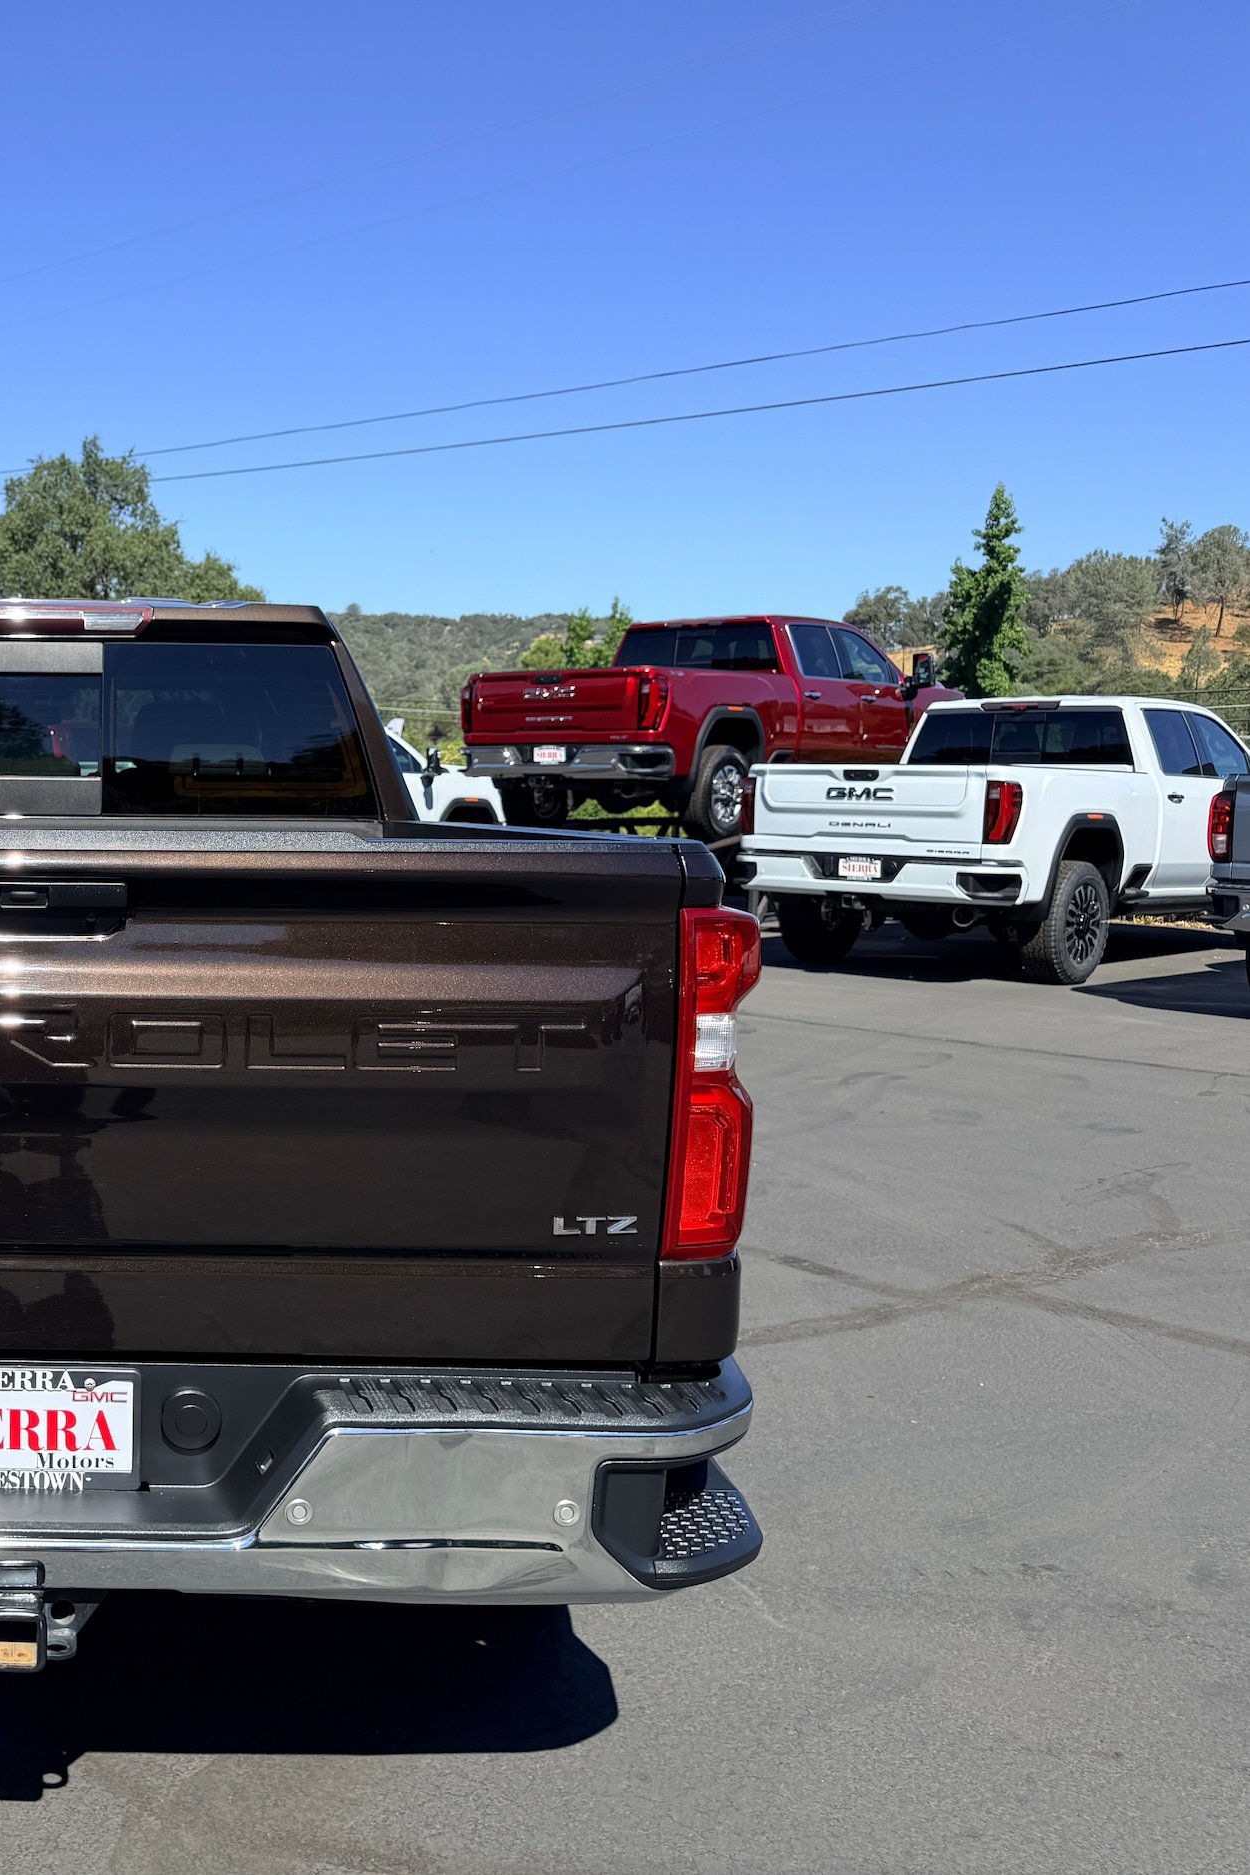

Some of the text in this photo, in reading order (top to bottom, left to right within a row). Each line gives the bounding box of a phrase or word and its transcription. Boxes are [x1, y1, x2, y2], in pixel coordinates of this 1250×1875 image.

[825, 787, 895, 801] GMC
[828, 821, 891, 829] DENALI
[842, 864, 878, 873] SIERRA
[552, 1216, 638, 1235] LTZ
[71, 1390, 128, 1403] GMC
[36, 1452, 115, 1470] Motors
